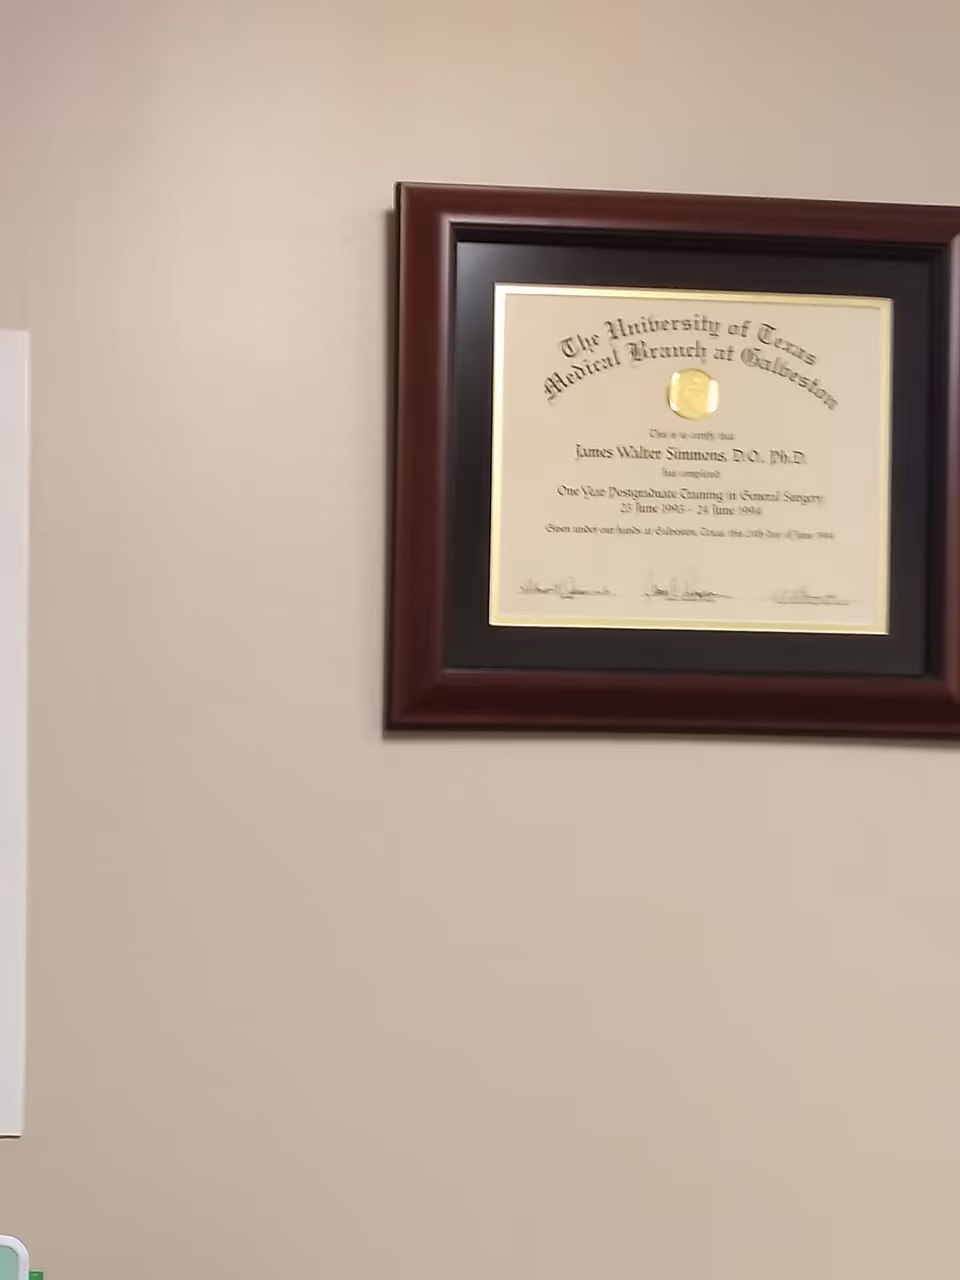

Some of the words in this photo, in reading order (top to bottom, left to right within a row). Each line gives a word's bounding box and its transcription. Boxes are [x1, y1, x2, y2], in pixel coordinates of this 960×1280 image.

[558, 333, 601, 359] The
[604, 313, 721, 340] University
[727, 319, 752, 338] of
[757, 321, 818, 367] Texas
[543, 348, 621, 405] Medical
[626, 339, 708, 367] Branch
[713, 344, 735, 362] at
[740, 346, 839, 412] Galveston
[575, 443, 614, 462] James
[616, 445, 662, 460] Walter
[666, 447, 727, 463] Simmons,
[557, 484, 580, 497] One
[581, 485, 607, 500] Year
[608, 486, 677, 501] Postgraduate
[680, 487, 723, 504] Training
[635, 501, 659, 516] June
[712, 504, 736, 518] June
